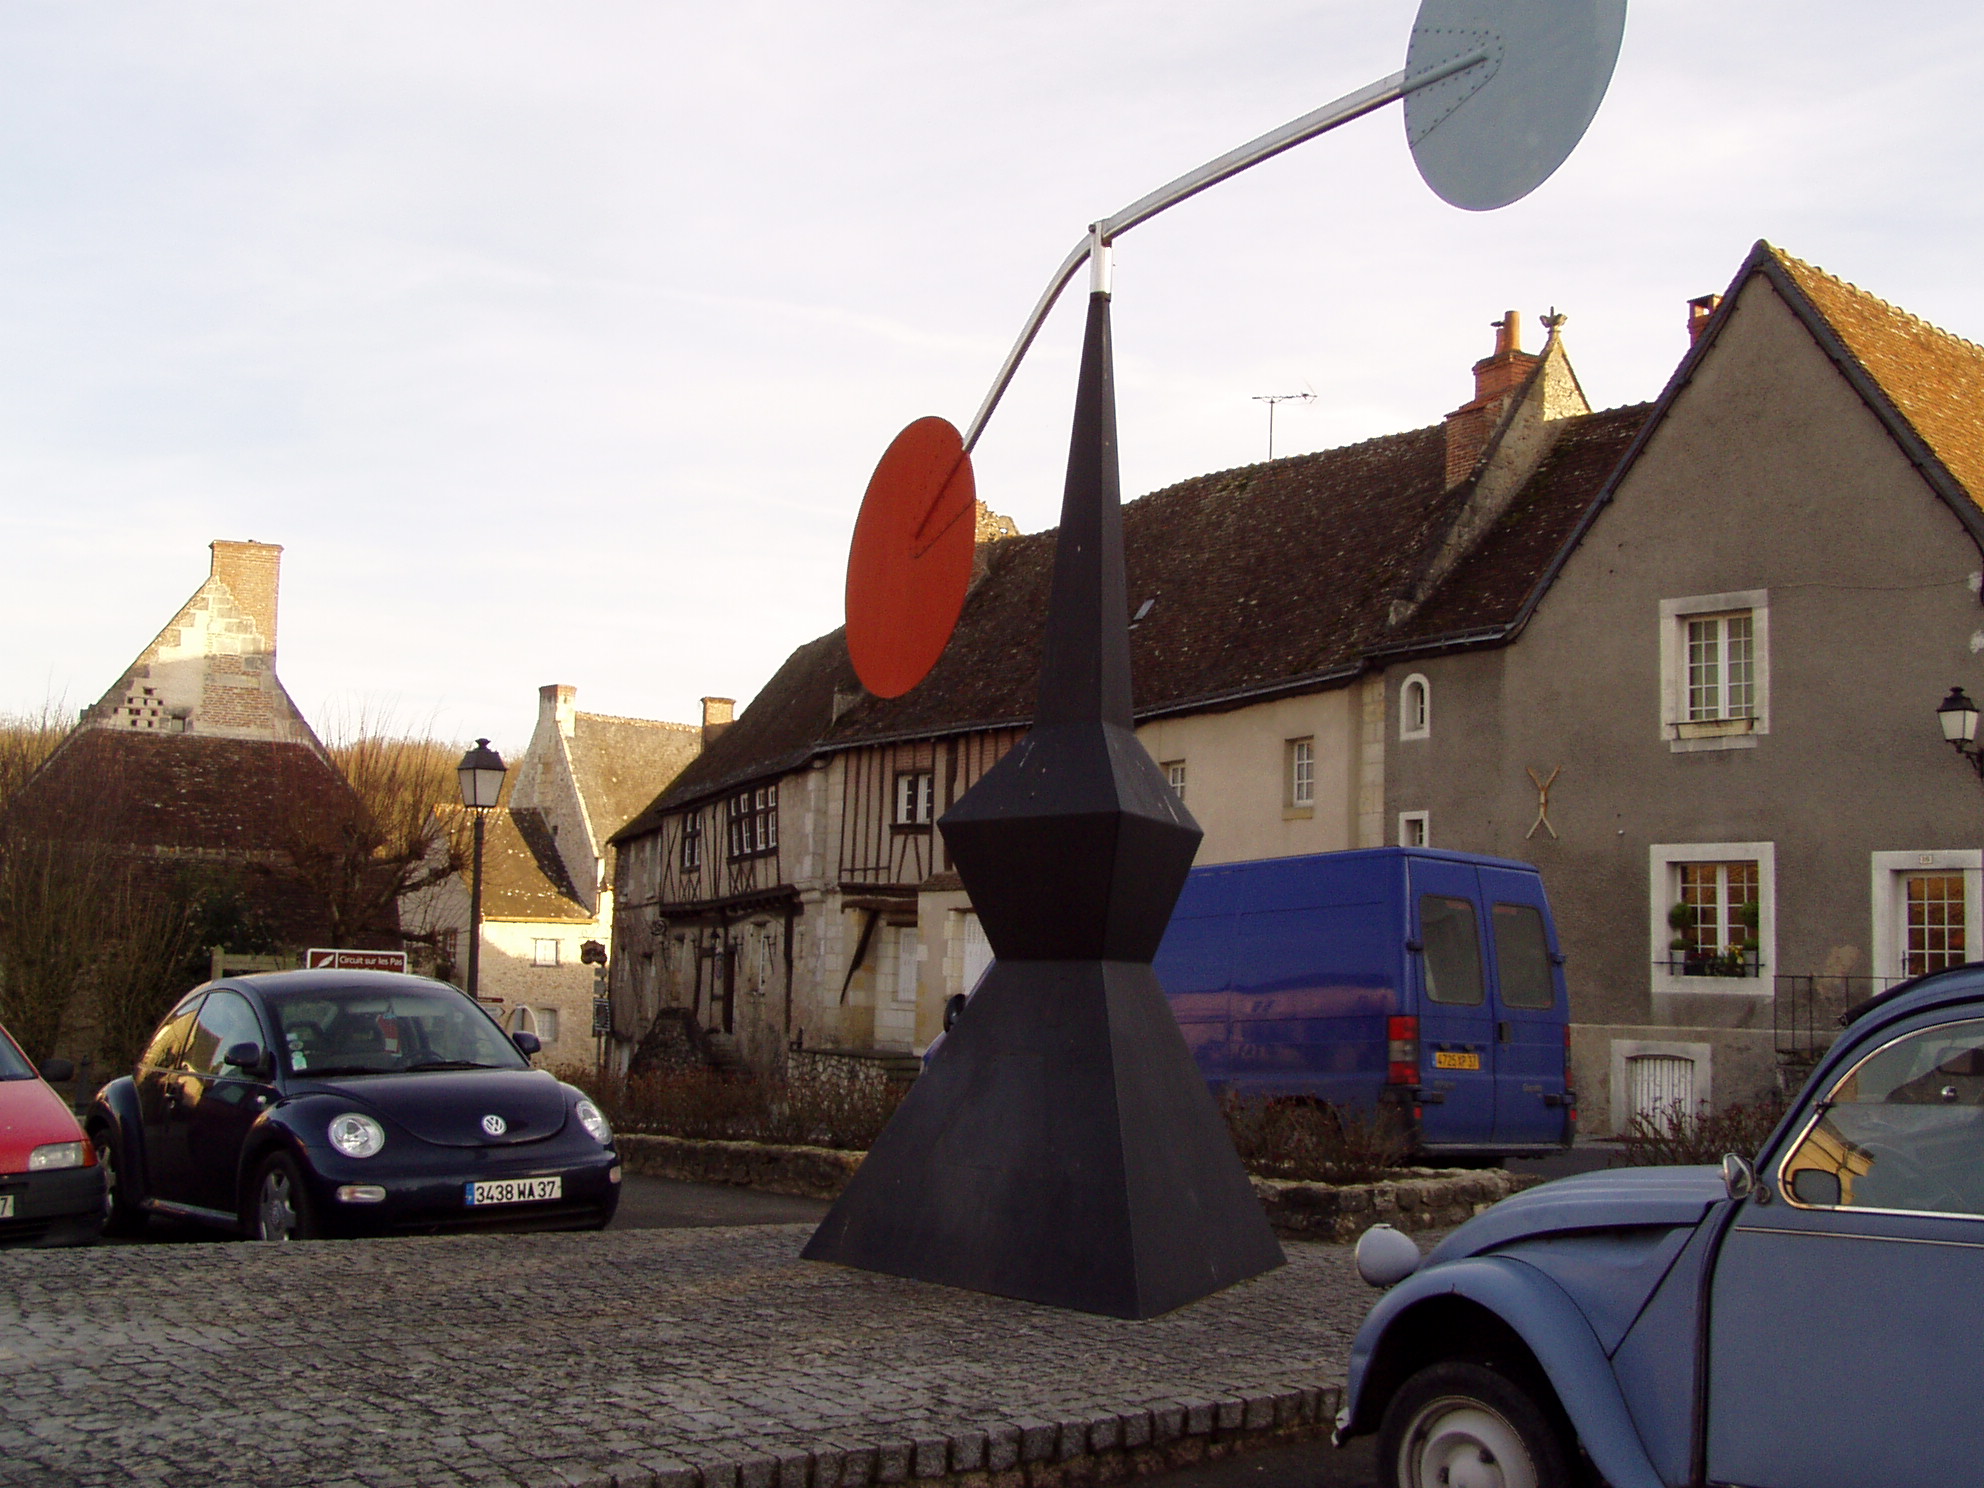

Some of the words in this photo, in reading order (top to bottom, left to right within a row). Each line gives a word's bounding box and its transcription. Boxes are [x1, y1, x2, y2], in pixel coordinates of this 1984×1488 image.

[340, 956, 363, 964] Circuit
[378, 957, 388, 965] les
[390, 957, 402, 966] Pas
[476, 1183, 514, 1203] 3438
[517, 1182, 536, 1200] WA
[538, 1181, 555, 1198] 37
